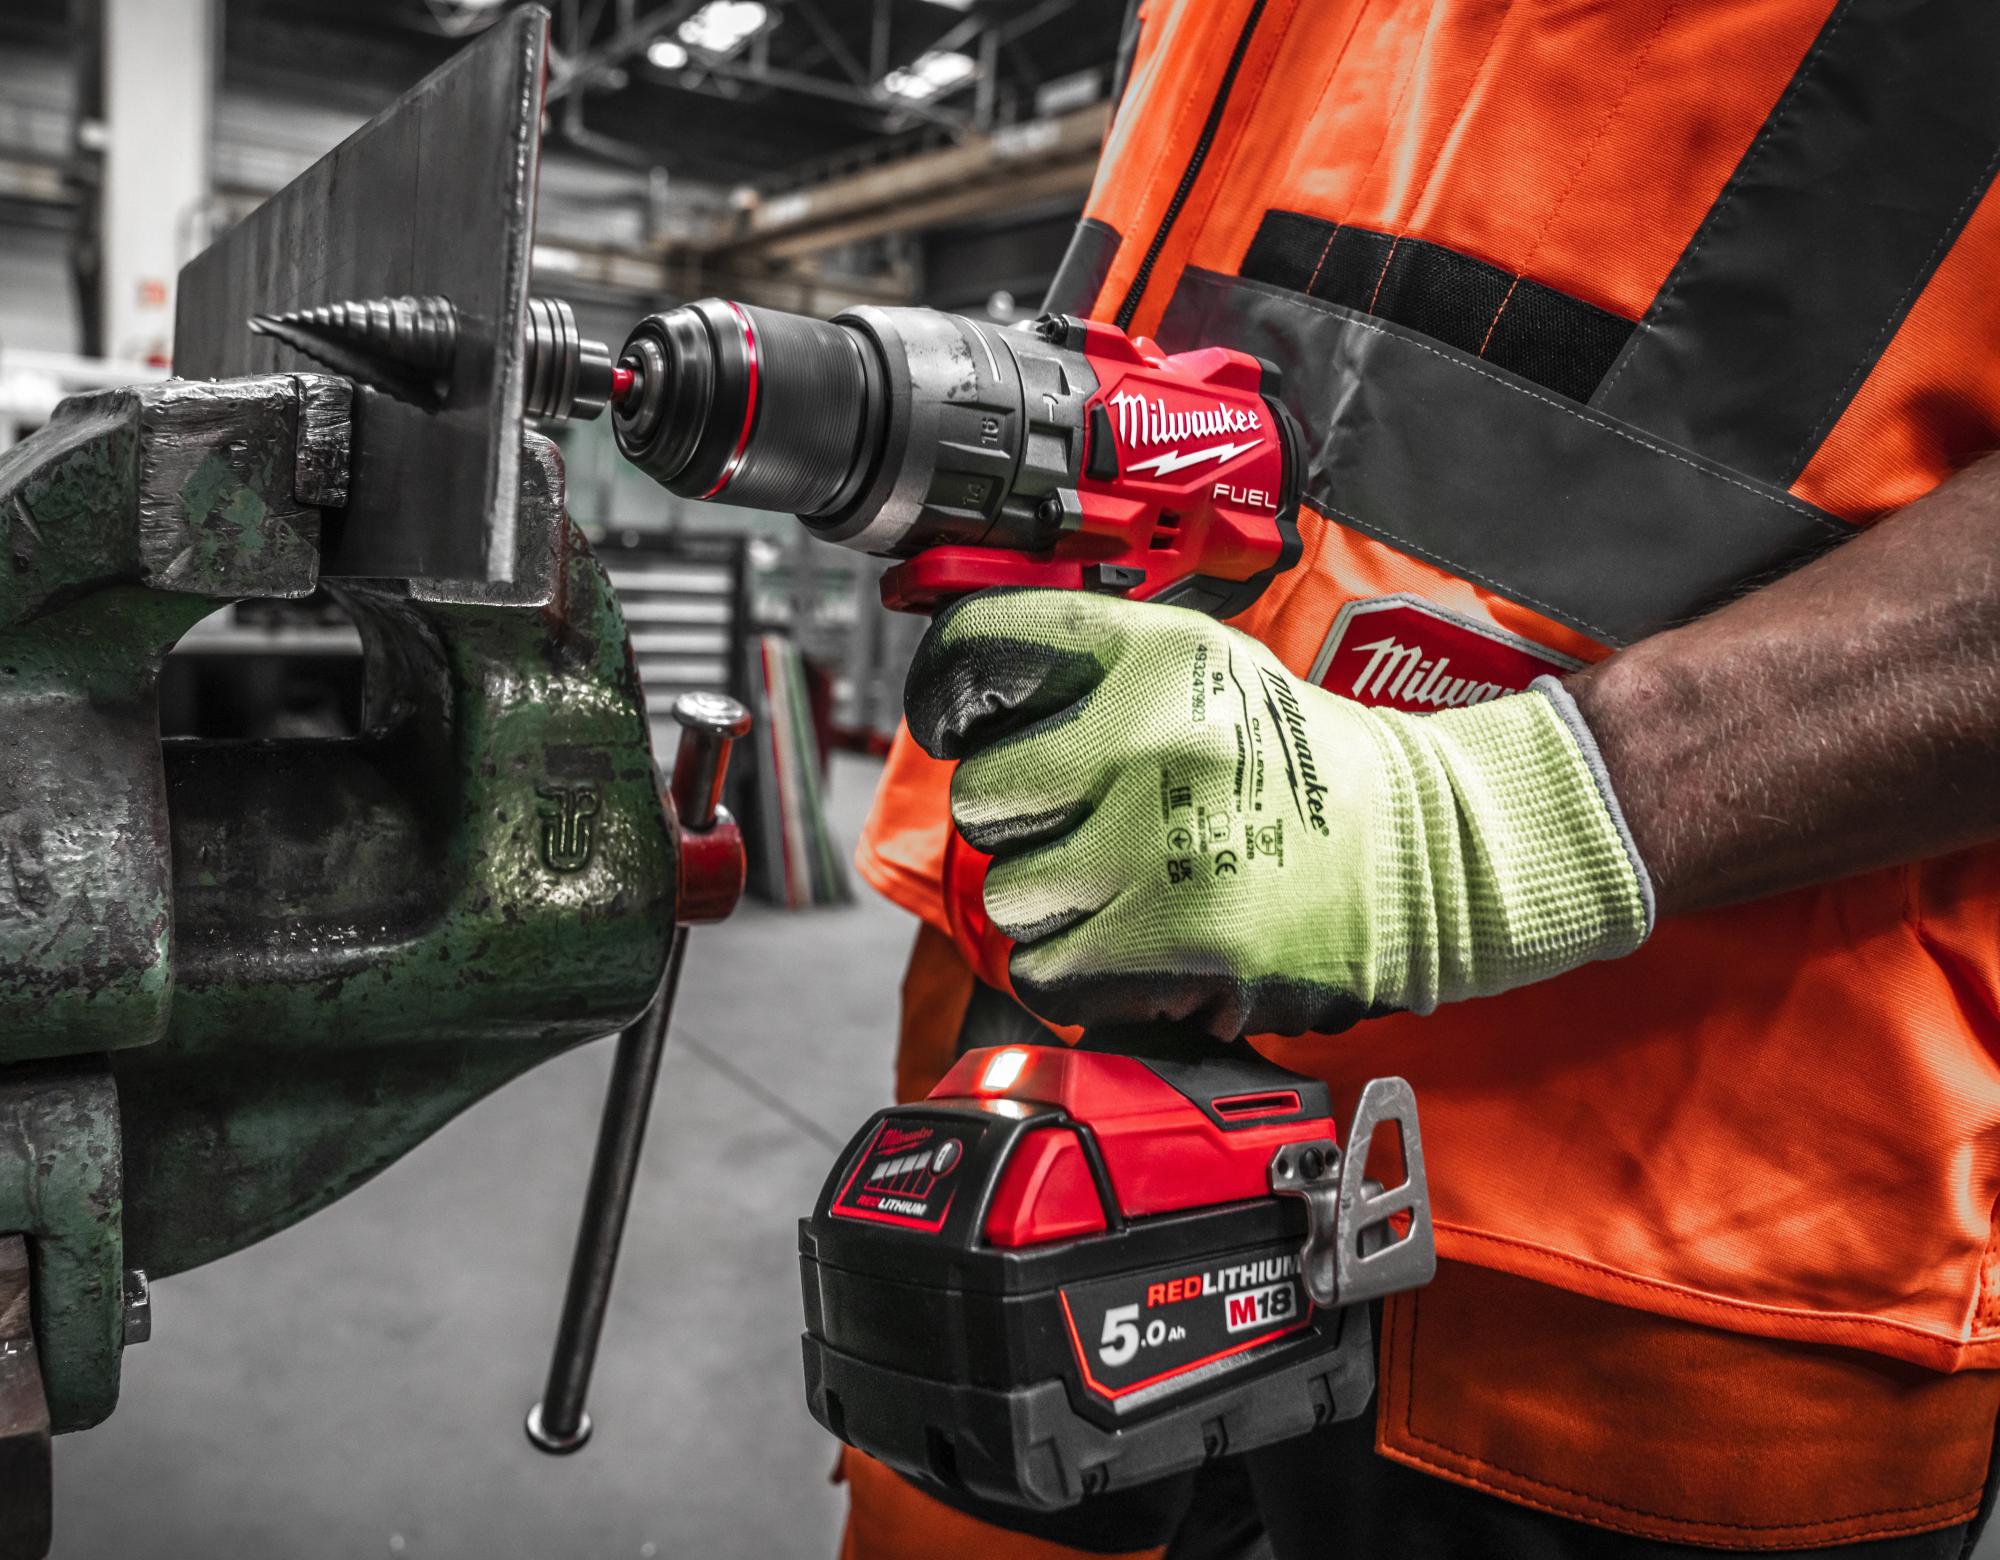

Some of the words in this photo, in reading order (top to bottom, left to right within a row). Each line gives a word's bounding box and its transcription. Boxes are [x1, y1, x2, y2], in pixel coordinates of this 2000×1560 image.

[981, 416, 1000, 444] 16
[1109, 389, 1263, 449] Milwaukee
[1213, 483, 1277, 509] FUEL
[1212, 671, 1225, 695] 9/L
[1252, 717, 1262, 744] CUT
[1255, 750, 1264, 797] LEVEL
[1229, 1285, 1293, 1327] M18
[1168, 1325, 1187, 1343] Ah
